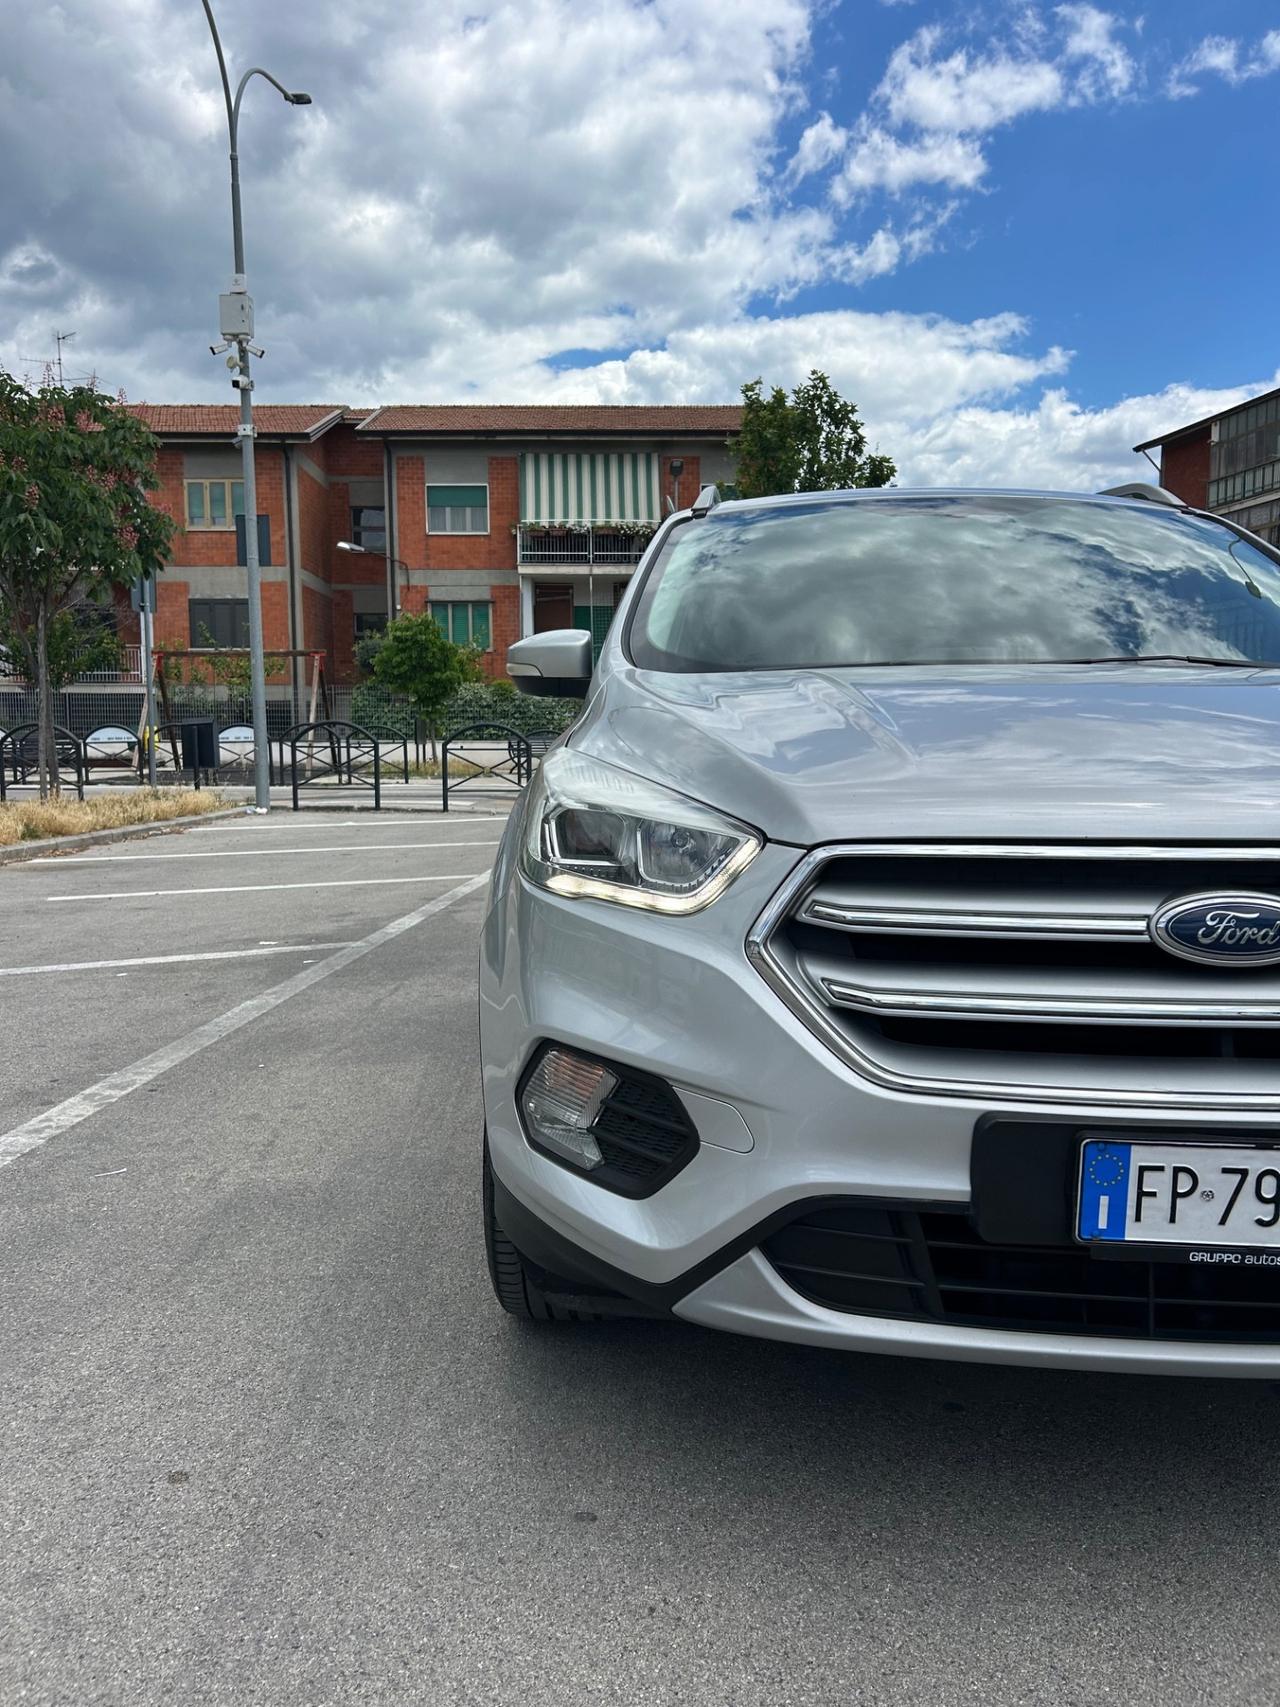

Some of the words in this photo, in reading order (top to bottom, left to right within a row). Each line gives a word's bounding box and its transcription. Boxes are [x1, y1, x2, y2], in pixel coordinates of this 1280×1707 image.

[1198, 910, 1280, 945] Ford
[1134, 1164, 1199, 1224] FP
[1217, 1166, 1280, 1228] 79
[1189, 1251, 1241, 1264] GRUPPO
